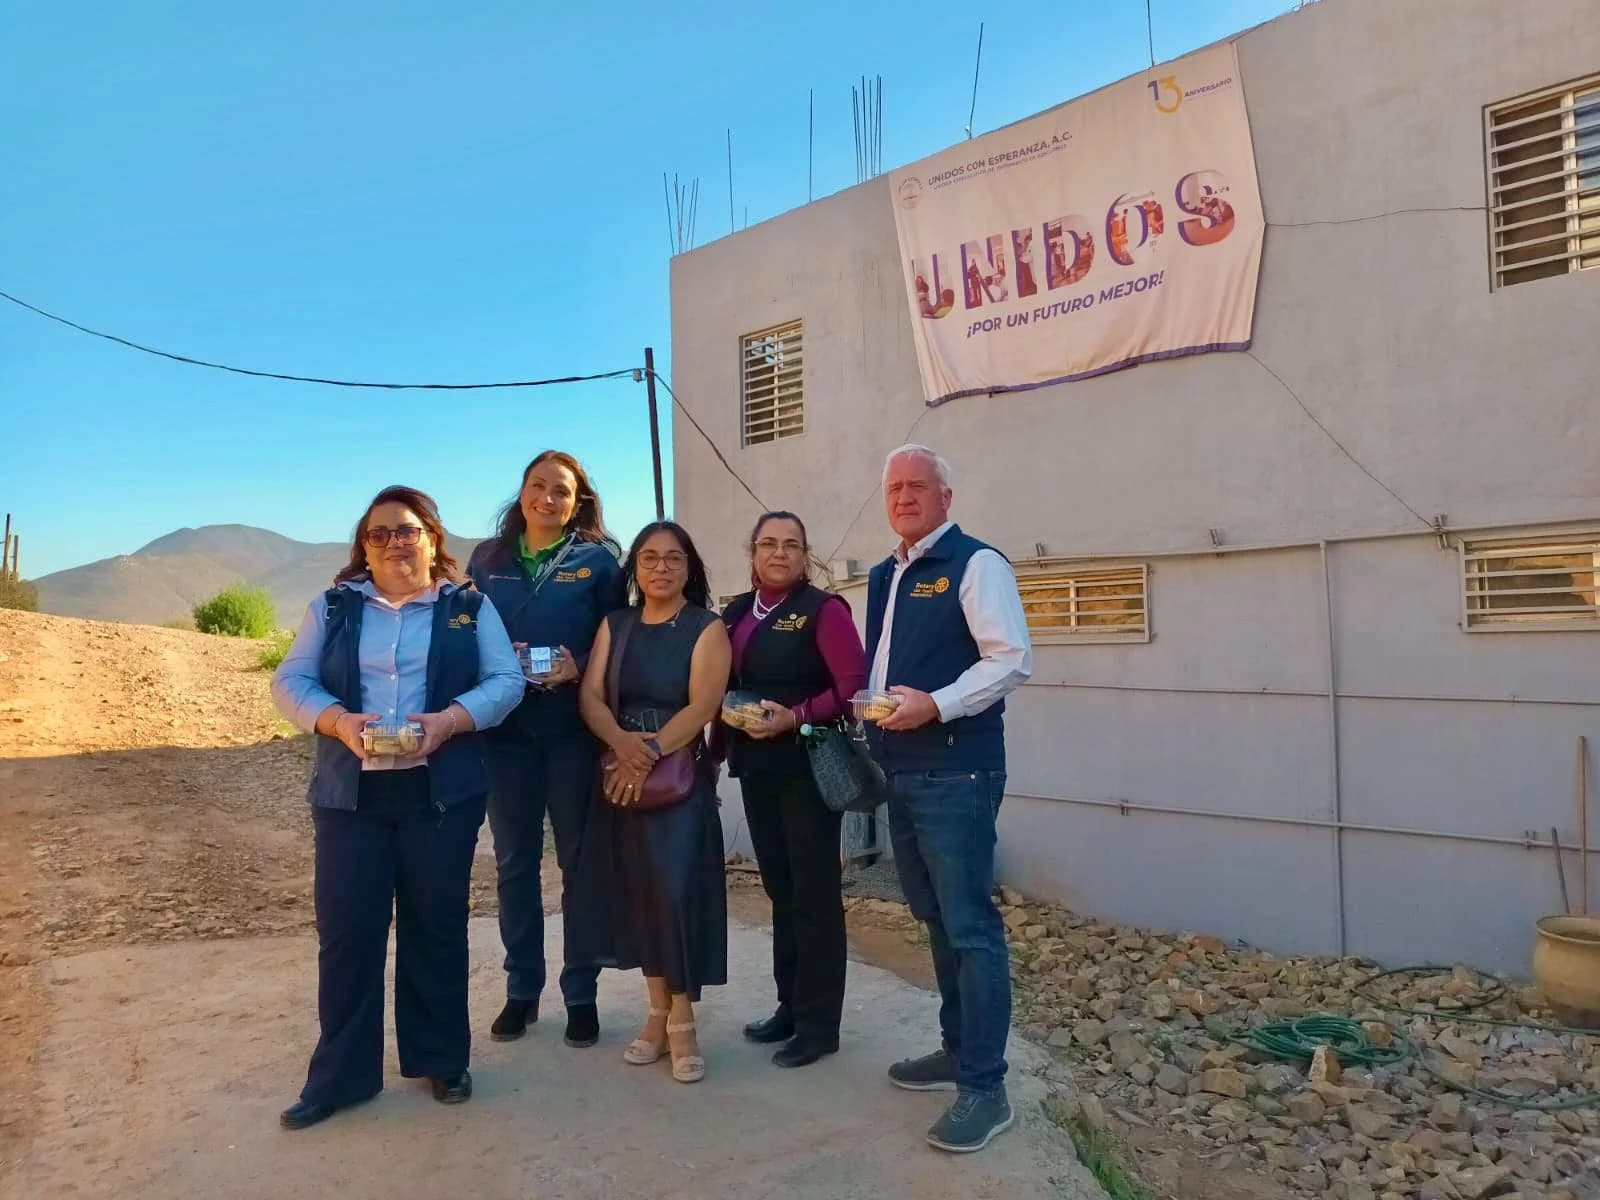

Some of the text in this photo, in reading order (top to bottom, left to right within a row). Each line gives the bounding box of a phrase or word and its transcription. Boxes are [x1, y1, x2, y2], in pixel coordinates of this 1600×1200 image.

[1147, 75, 1232, 113] 13 ANIVERSARIO
[928, 167, 965, 186] UNIDOS
[966, 159, 986, 173] CON
[1051, 131, 1073, 146] A.C.
[912, 169, 1236, 319] UNIDOS
[966, 270, 1165, 338] ¡POR UN FUTURO MEJOR!
[915, 582, 935, 590] Rotary
